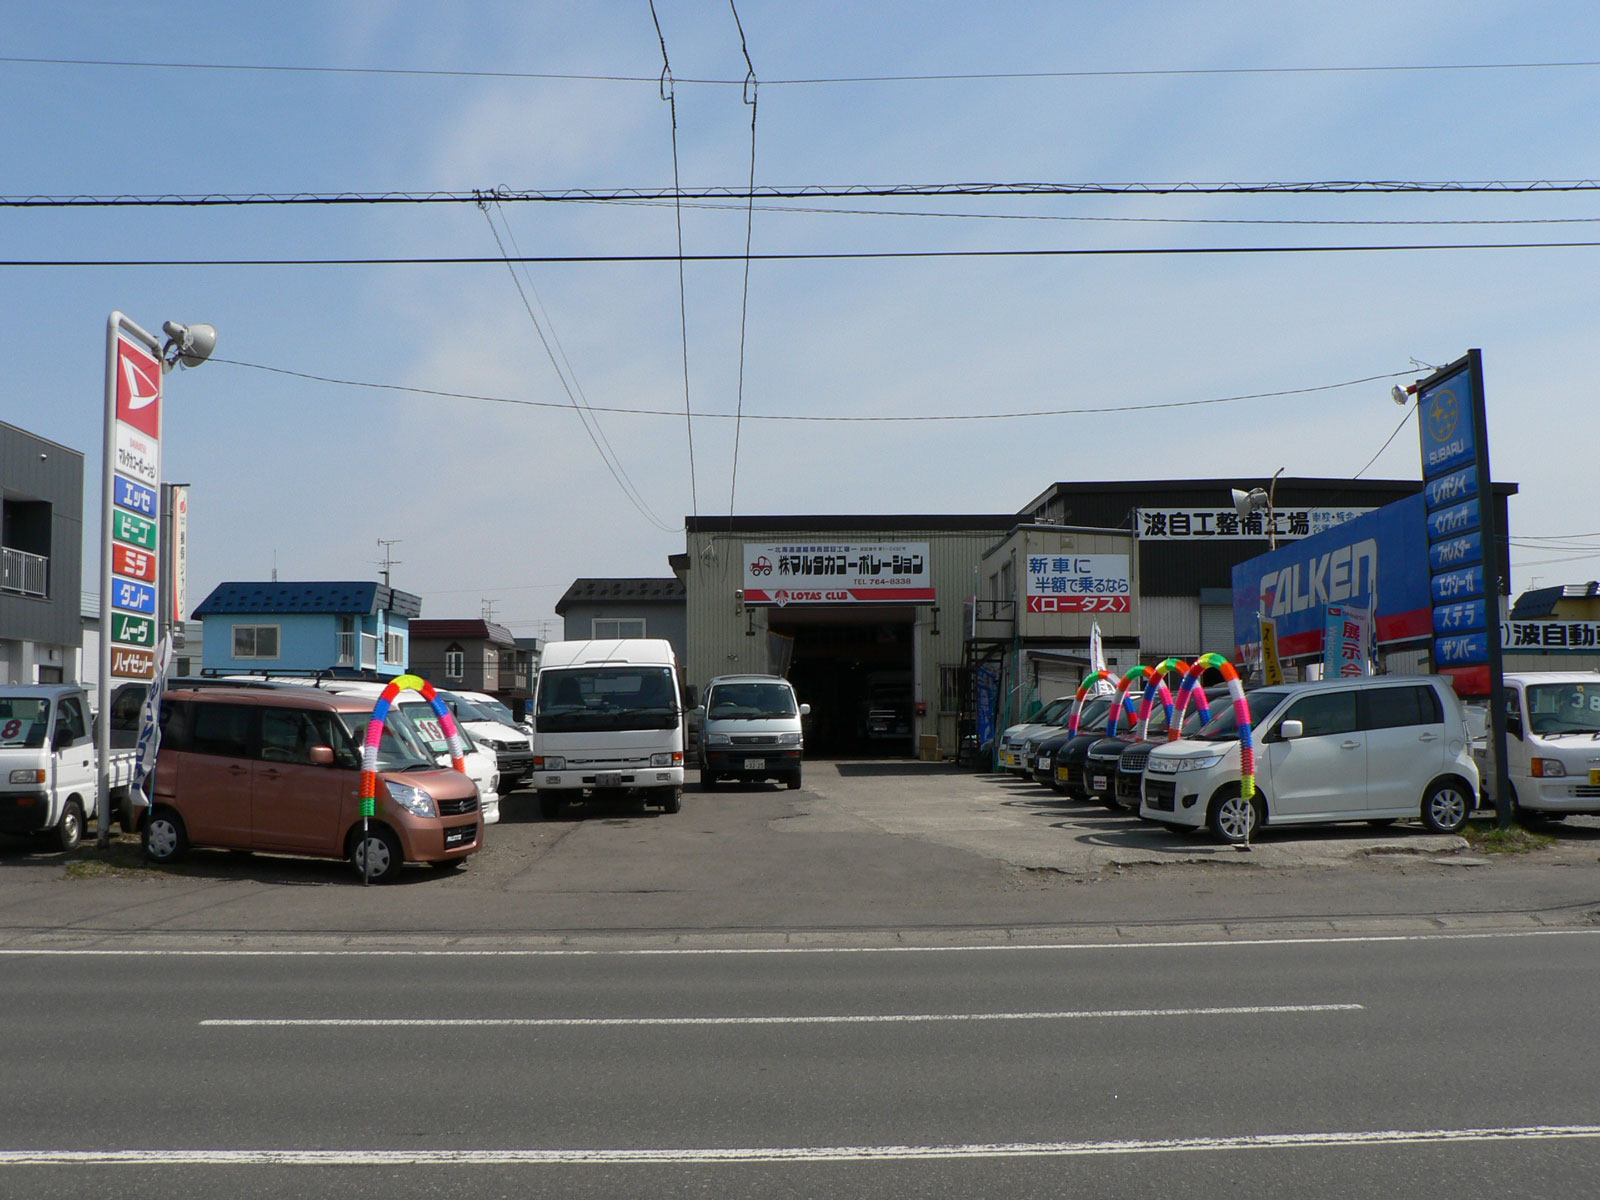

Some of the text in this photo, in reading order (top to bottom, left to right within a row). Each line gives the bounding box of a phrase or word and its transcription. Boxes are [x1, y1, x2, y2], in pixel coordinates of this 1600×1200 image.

[1429, 439, 1464, 465] SUBARU
[123, 482, 151, 513] エッセ
[1144, 512, 1309, 537] 波自工整備工場
[124, 550, 148, 577] ミラ
[1029, 557, 1091, 574] 新車に
[869, 577, 911, 586] 764-8338
[1035, 576, 1128, 594] 半額で乗るなら
[1260, 538, 1377, 617] FALKEN
[1439, 570, 1474, 596] エクシーガ
[121, 583, 149, 609] タント
[791, 592, 848, 601] LOTAS CLUB
[1442, 604, 1475, 627] ステラ
[120, 616, 149, 643] ムーヴ
[1340, 621, 1362, 678] 展示会
[1442, 638, 1477, 660] サンバー
[114, 652, 153, 674] ハイゼット
